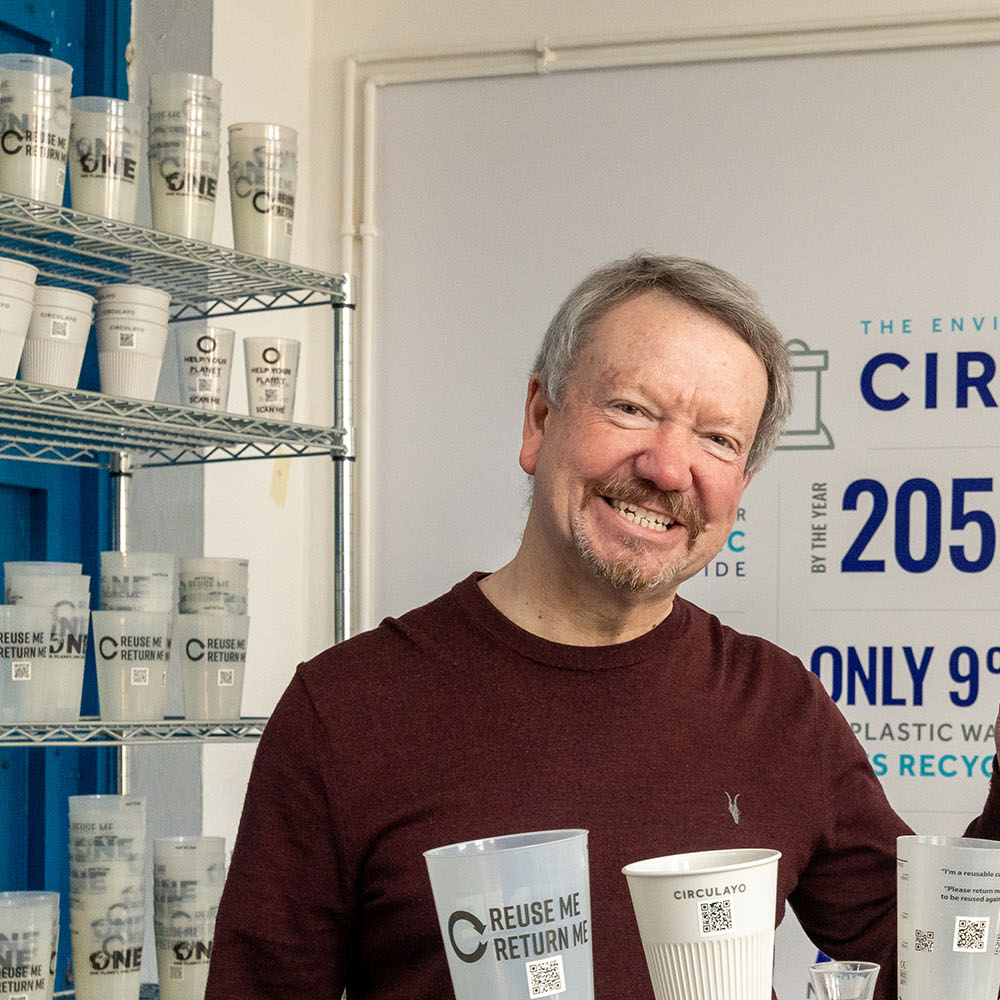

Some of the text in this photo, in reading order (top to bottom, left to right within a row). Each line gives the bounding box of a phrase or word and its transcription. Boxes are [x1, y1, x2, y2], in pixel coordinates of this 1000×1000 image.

[860, 319, 912, 335] THE
[810, 482, 829, 574] BY THE YEAR
[32, 631, 45, 644] ME
[120, 635, 163, 648] REUSE ME
[207, 638, 246, 650] REUSE ME
[120, 650, 156, 661] RETURN
[207, 652, 240, 663] RETURN
[809, 645, 935, 707] ONLY
[851, 722, 953, 742] PLASTIC
[673, 883, 748, 901] CIRCULAYO
[489, 891, 581, 932] REUSE ME
[494, 919, 589, 962] RETURN ME
[30, 965, 43, 977] ME
